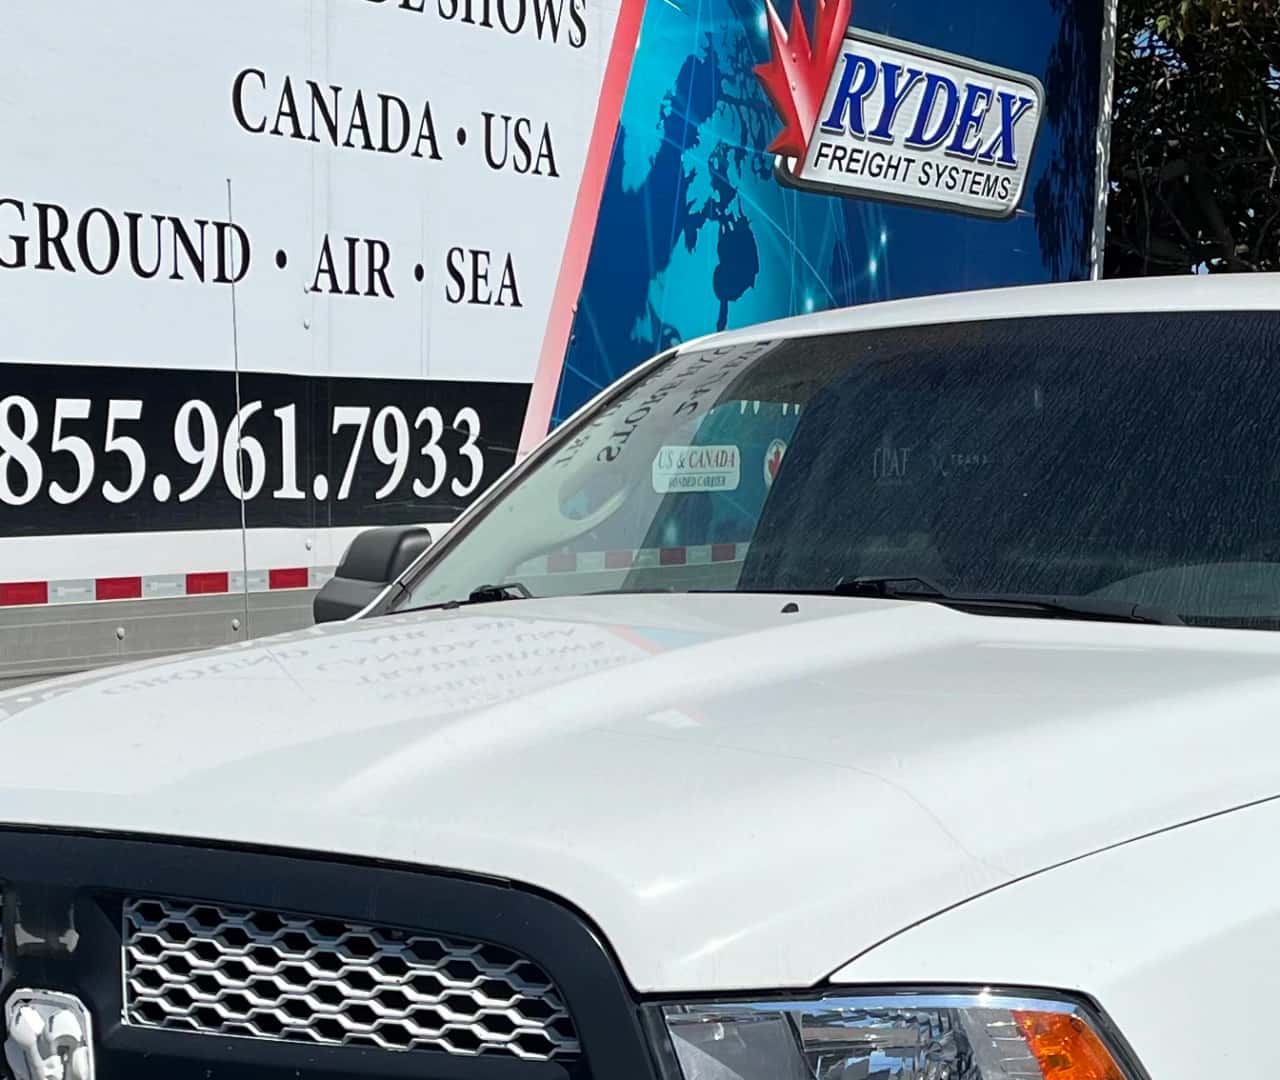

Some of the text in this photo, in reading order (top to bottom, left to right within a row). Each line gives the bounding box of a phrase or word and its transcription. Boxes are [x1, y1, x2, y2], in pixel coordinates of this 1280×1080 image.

[232, 68, 560, 178] CANADA USA
[821, 52, 1033, 168] RYDEX
[813, 142, 1012, 201] FREIGHT SYSTEMS
[309, 233, 395, 298] AIR
[445, 247, 523, 307] SEA
